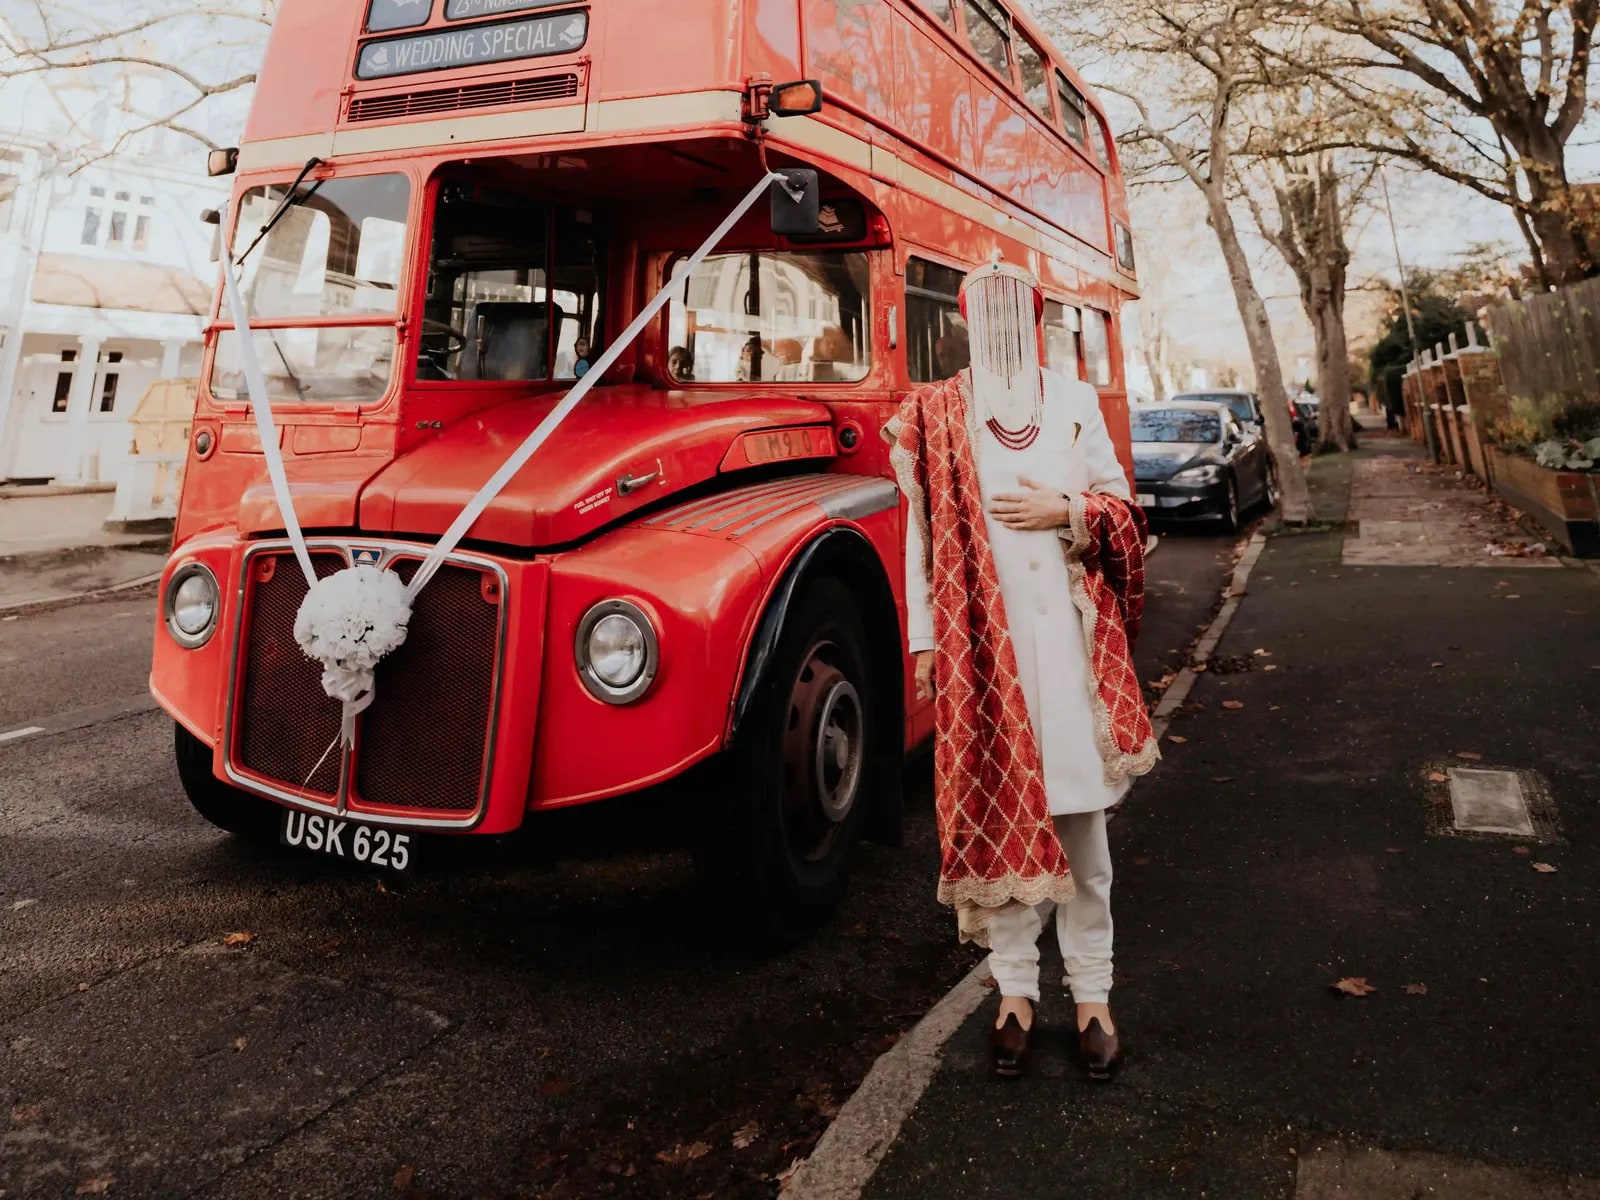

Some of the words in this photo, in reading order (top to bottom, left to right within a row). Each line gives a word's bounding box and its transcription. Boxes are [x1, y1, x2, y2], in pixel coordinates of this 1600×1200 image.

[395, 33, 474, 69] WEDDING
[480, 23, 556, 56] SPECIAL
[286, 810, 347, 857] USK
[353, 825, 410, 870] 625
